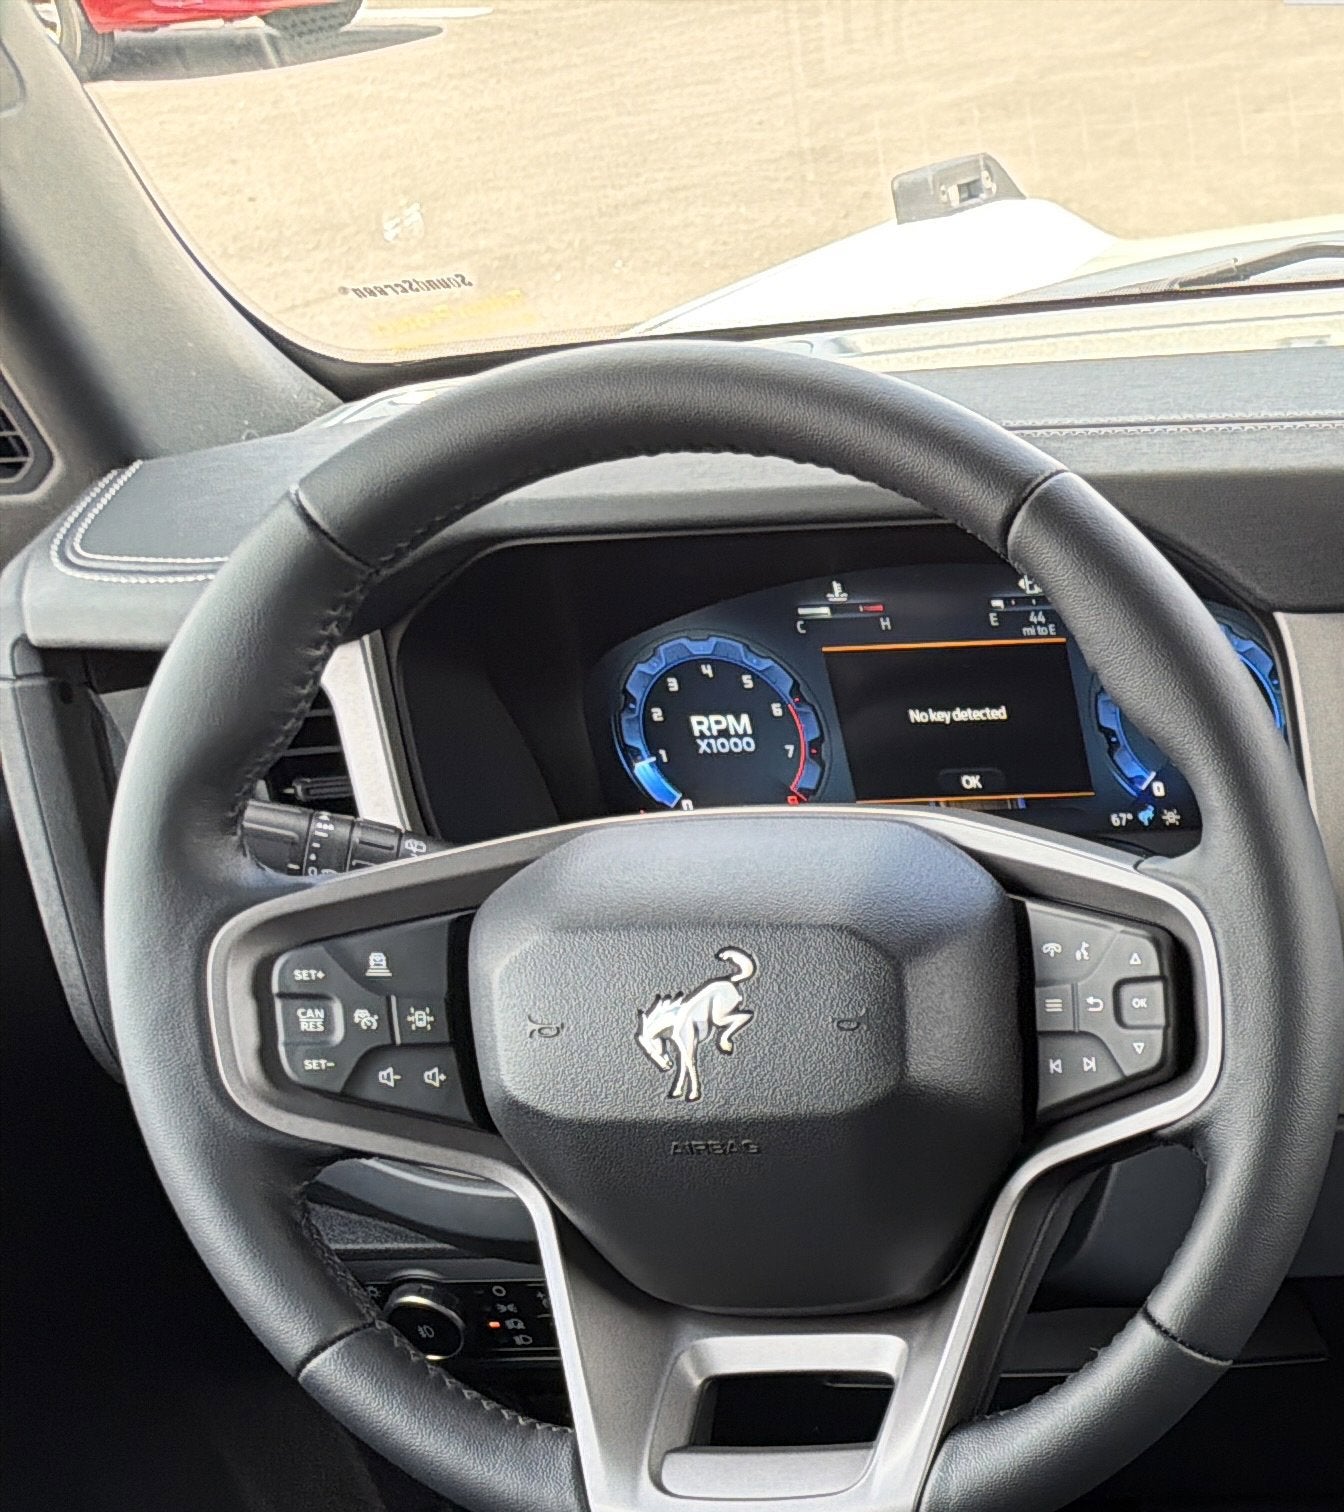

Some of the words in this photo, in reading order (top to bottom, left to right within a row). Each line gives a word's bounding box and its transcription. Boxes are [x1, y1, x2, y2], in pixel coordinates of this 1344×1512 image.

[880, 616, 891, 631] H
[989, 613, 999, 626] E
[1029, 611, 1046, 623] 44
[796, 620, 806, 634] C
[700, 664, 714, 678] 4
[667, 677, 679, 691] 3
[741, 674, 754, 689] 5
[651, 707, 664, 721] 2
[771, 702, 783, 717] 6
[908, 708, 928, 724] No
[928, 708, 951, 724] key
[952, 705, 1008, 722] detected
[690, 713, 753, 737] RPM
[695, 737, 756, 754] X1000
[784, 745, 794, 758] 7
[659, 749, 668, 763] 1
[960, 774, 983, 790] OK
[1131, 997, 1148, 1009] OK
[296, 1008, 325, 1019] CAN
[300, 1021, 325, 1032] RES
[670, 1139, 760, 1155] AIRBAG
